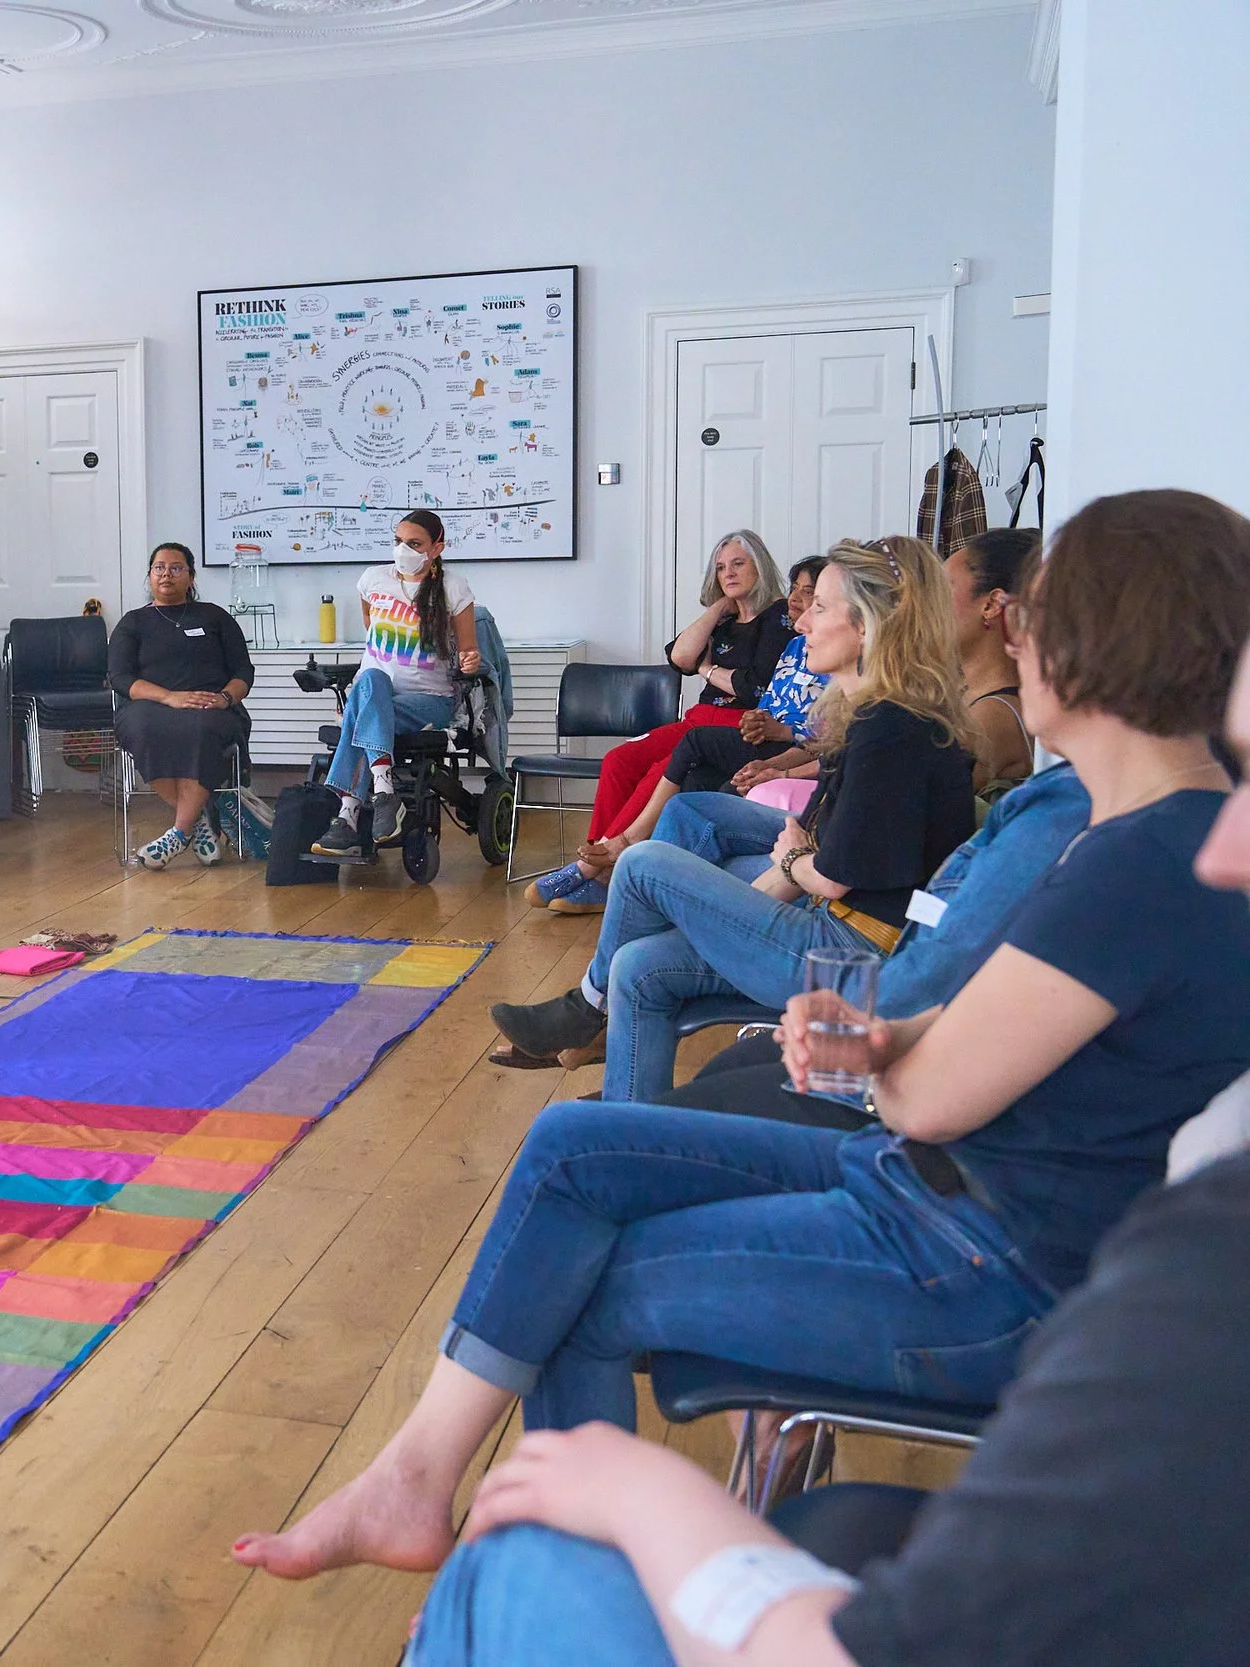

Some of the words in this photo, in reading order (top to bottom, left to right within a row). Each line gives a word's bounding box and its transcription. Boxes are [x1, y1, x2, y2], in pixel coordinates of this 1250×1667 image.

[215, 299, 286, 315] RETHINK
[482, 300, 525, 311] STORIES
[219, 313, 286, 328] FASHION
[496, 323, 520, 331] Sophie
[332, 350, 371, 382] SYNERGIES
[517, 368, 538, 376] Adam
[232, 530, 273, 539] FASHION
[369, 592, 423, 627] CHOO
